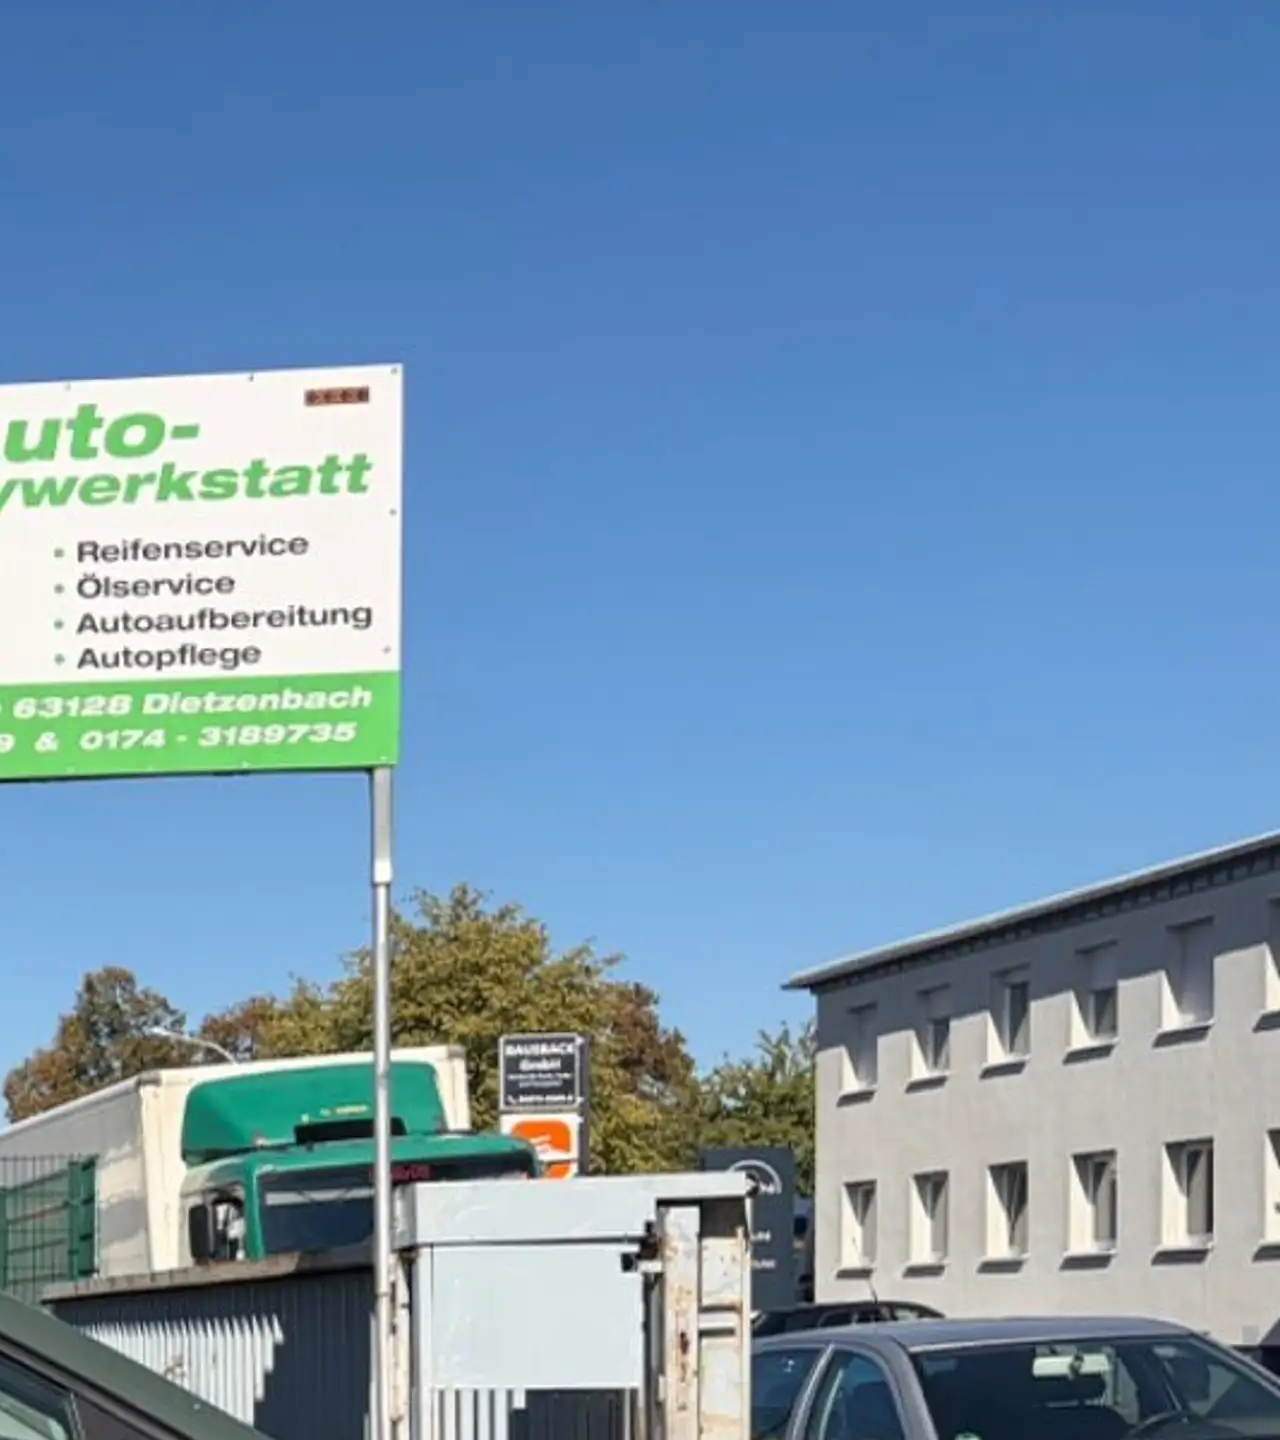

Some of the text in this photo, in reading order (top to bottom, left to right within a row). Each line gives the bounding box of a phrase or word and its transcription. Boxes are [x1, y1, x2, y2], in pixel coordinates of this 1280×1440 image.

[77, 534, 310, 563] Reifenservice
[77, 572, 235, 599] Ölservice
[76, 604, 373, 634] Autoaufbereitung
[76, 643, 262, 671] Autopflege
[12, 694, 132, 720] 63128
[142, 685, 372, 714] Dietzenbach
[79, 727, 167, 750] 0174
[197, 722, 358, 748] 3189735
